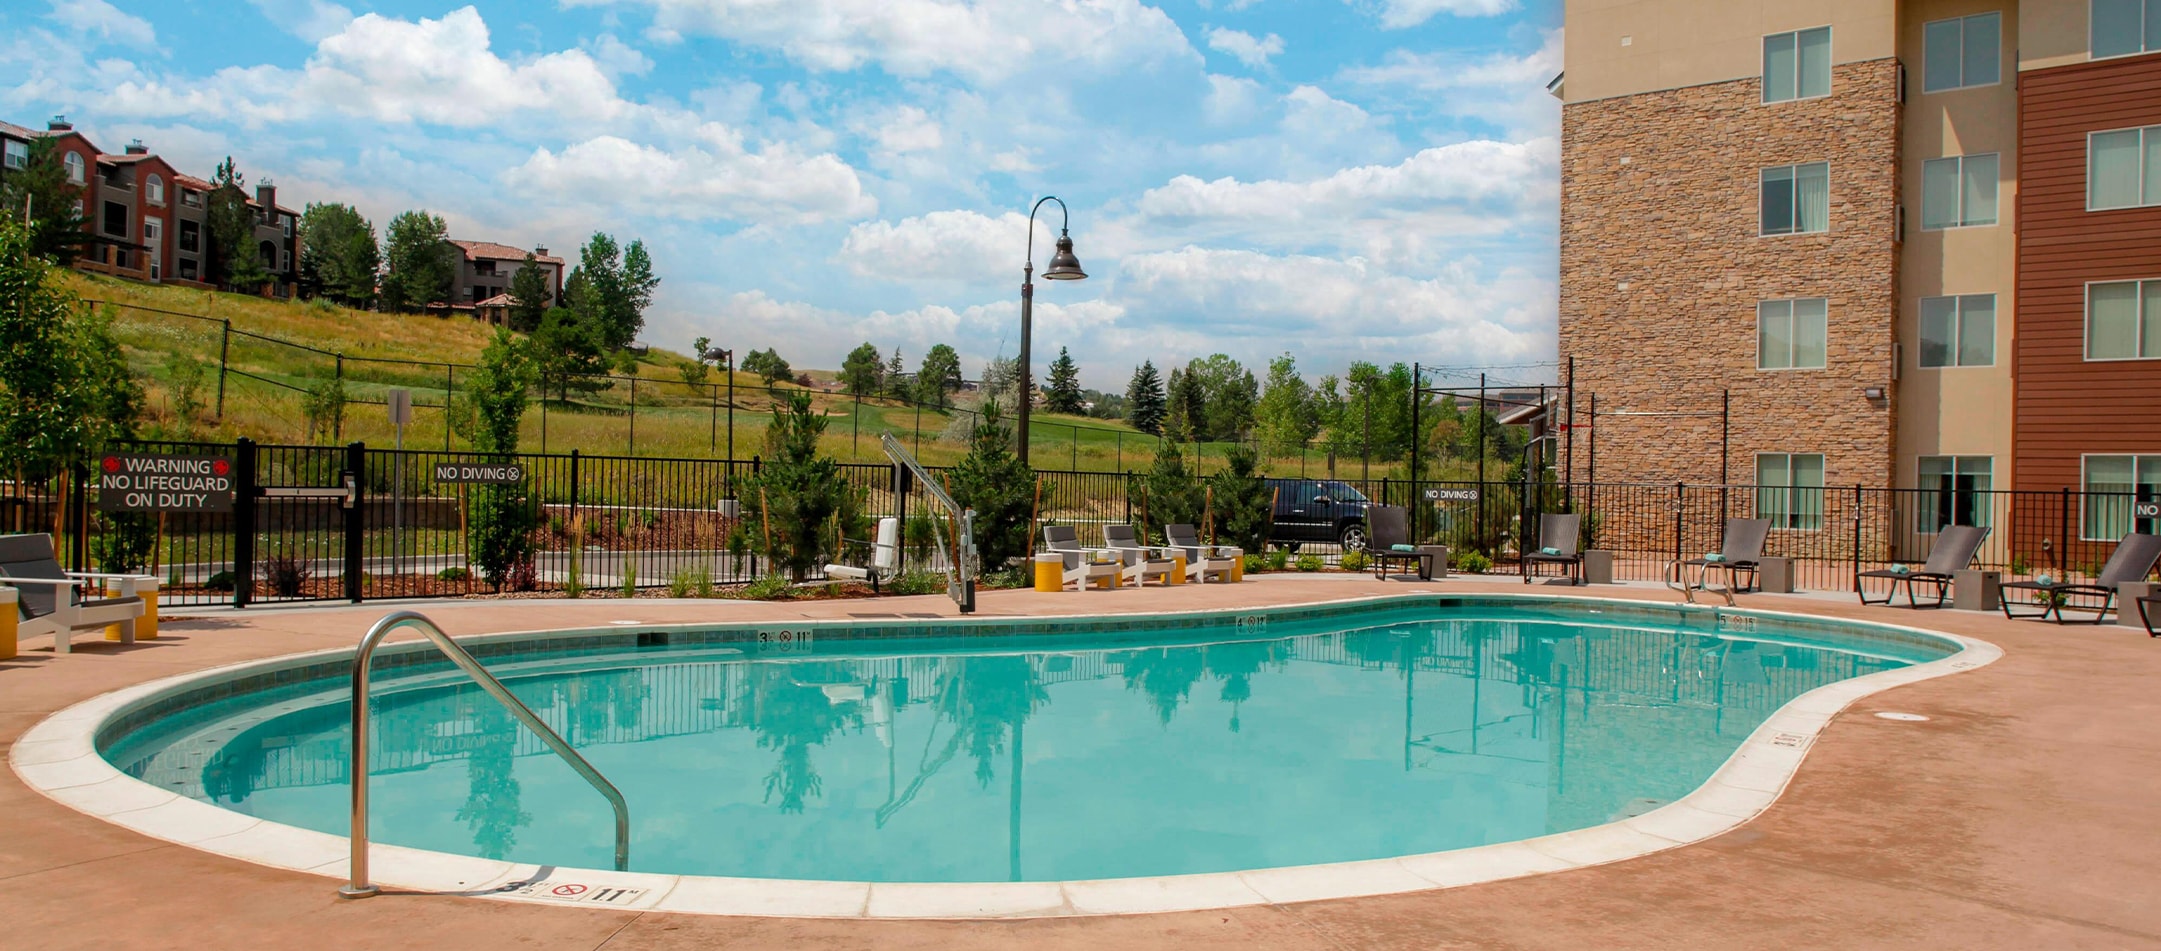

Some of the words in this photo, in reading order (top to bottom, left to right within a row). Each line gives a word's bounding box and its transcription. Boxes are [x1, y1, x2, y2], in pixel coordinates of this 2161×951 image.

[125, 458, 210, 474] WARNING
[437, 467, 457, 479] NO
[462, 467, 505, 479] DIVING
[102, 475, 130, 489] NO
[135, 475, 229, 491] LIFEGUARD
[125, 493, 152, 507] ON
[159, 494, 207, 507] DUTY
[1426, 490, 1438, 498] NO
[1440, 490, 1468, 499] DIVING
[2137, 505, 2158, 515] NO
